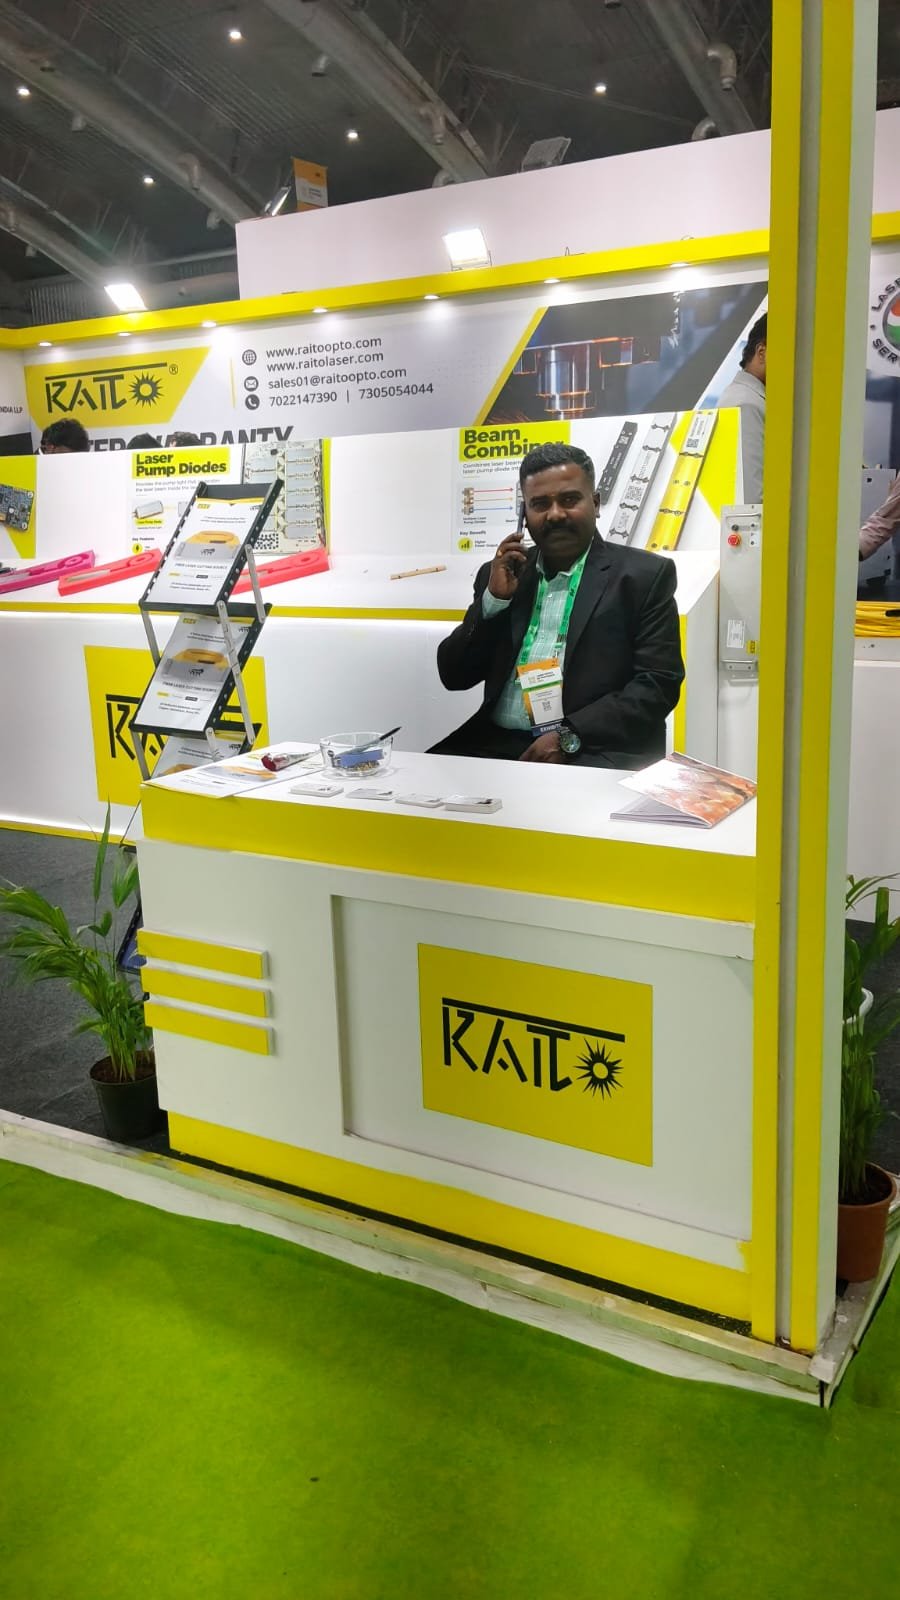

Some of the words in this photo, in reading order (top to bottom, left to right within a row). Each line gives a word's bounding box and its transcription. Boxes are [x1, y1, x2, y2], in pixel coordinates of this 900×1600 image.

[266, 338, 382, 358] www.raitoopto.com
[872, 338, 900, 364] SER
[266, 352, 384, 372] www.raitolaser.com
[268, 368, 407, 389] sales01@raitoopto.com
[269, 391, 338, 407] 7022147390
[358, 383, 434, 399] 7305054044
[464, 429, 521, 444] Beam
[136, 454, 174, 465] Laser
[136, 465, 176, 477] Pump
[179, 461, 226, 474] Diodes
